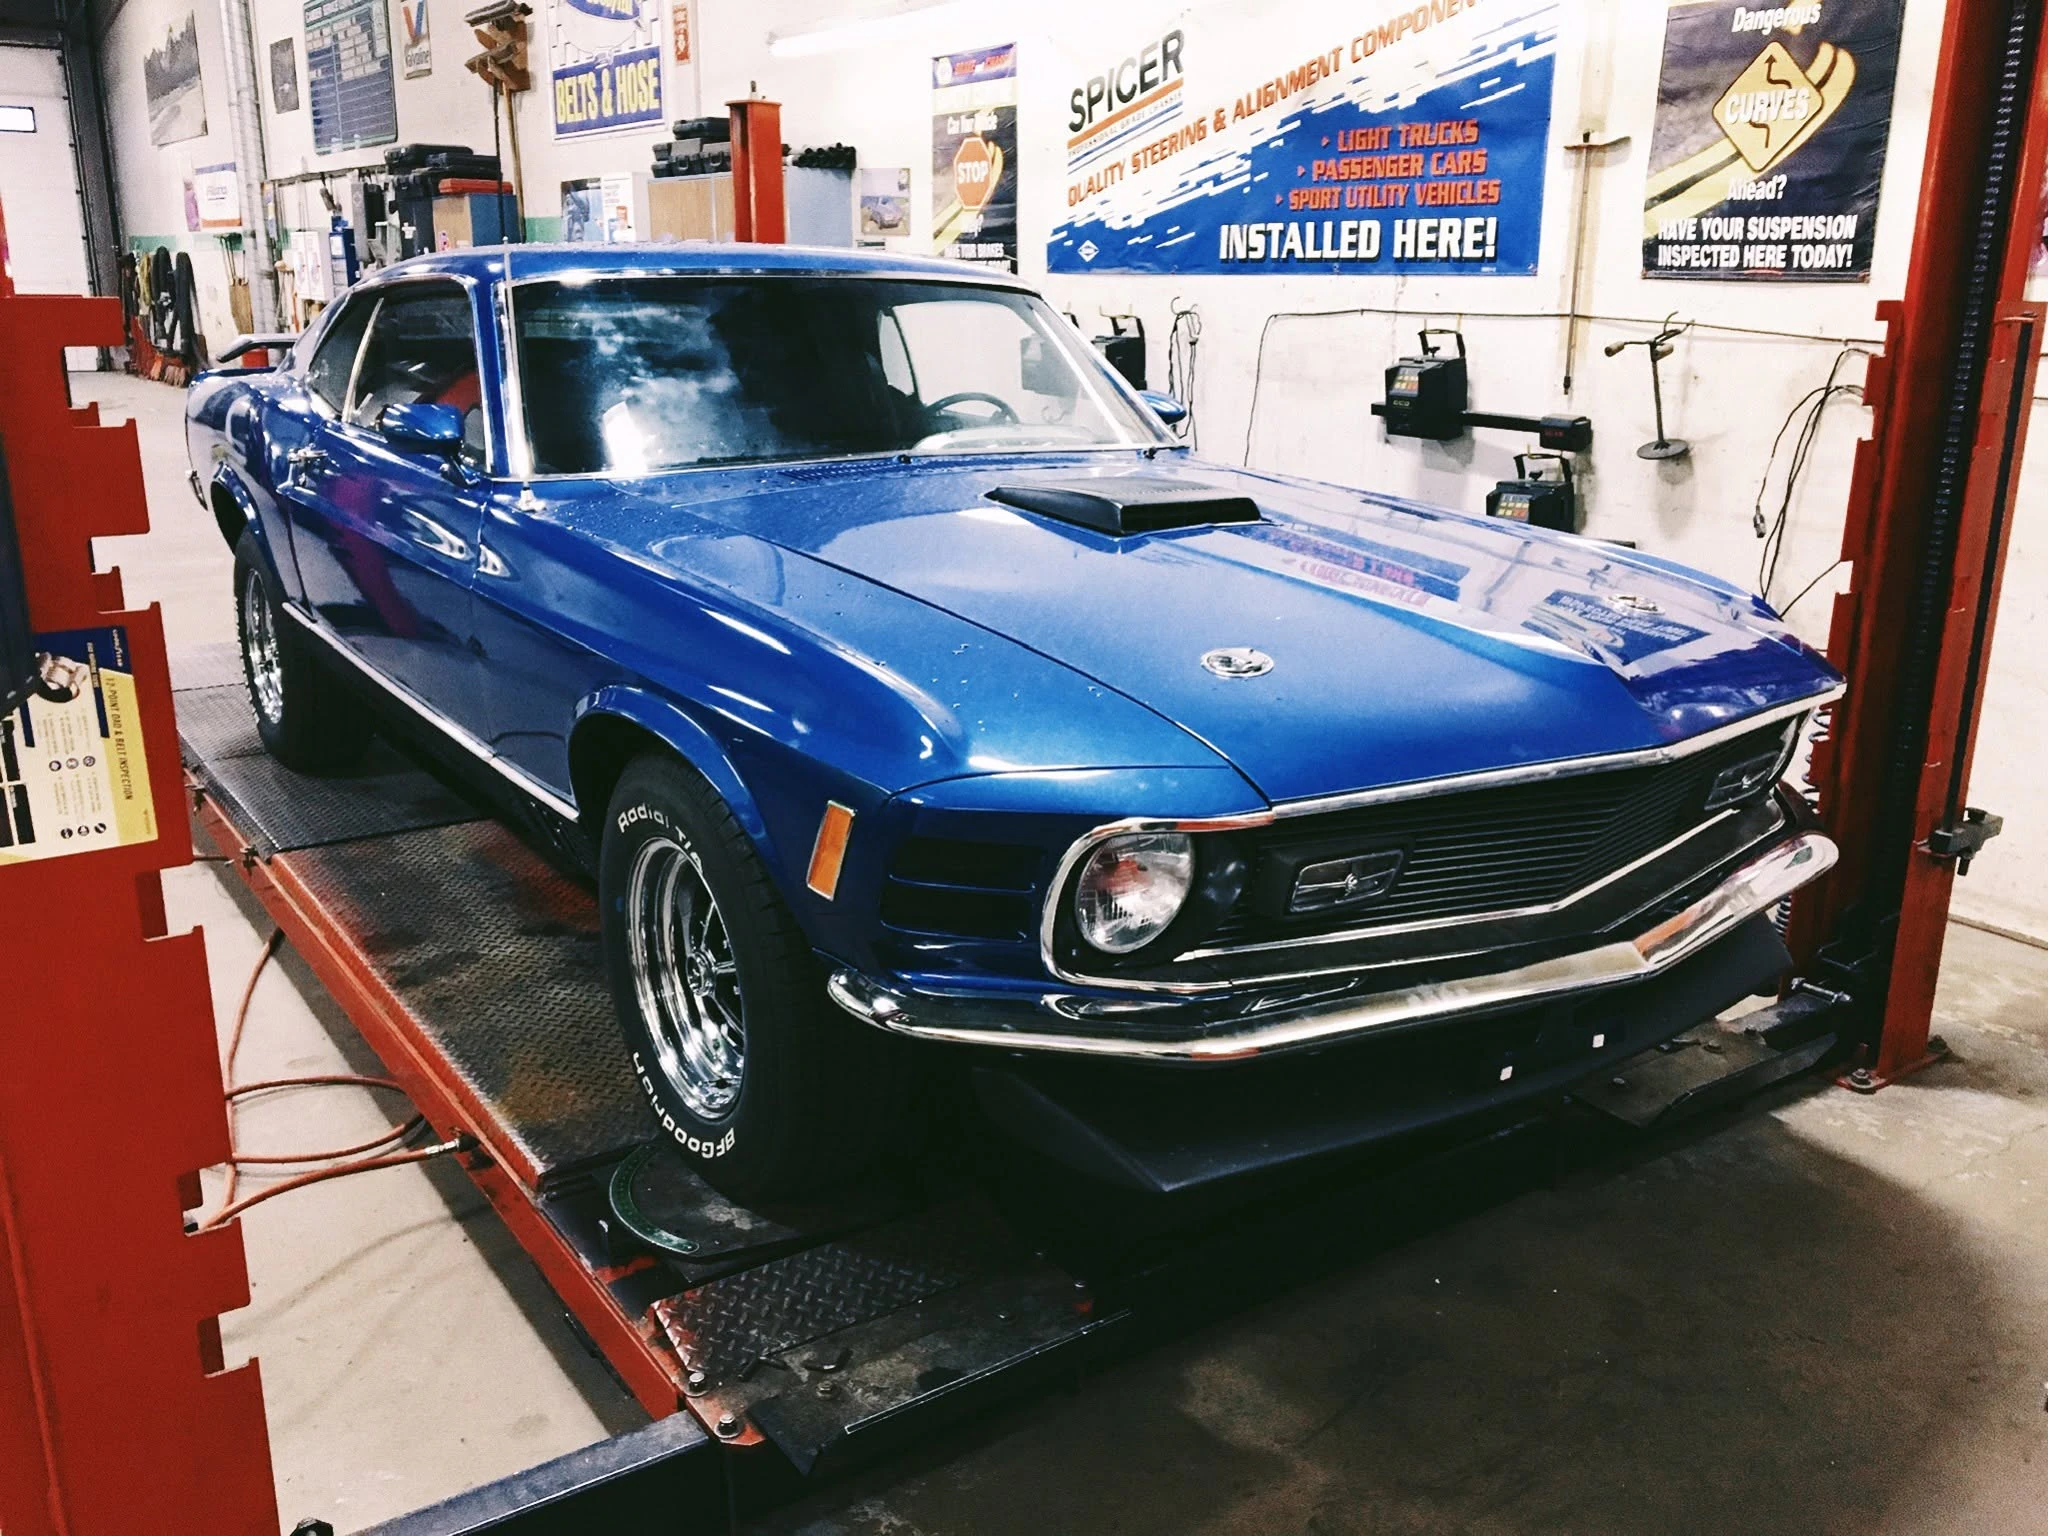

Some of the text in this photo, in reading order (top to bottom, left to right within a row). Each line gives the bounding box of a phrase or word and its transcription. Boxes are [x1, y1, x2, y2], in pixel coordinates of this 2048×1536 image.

[1731, 4, 1822, 35] Dangerous
[555, 58, 660, 124] BELTS & HOSE
[1069, 29, 1184, 132] SPICER
[1724, 88, 1811, 124] CURVES
[1068, 158, 1126, 207] QUALITY
[1131, 116, 1207, 174] STEERING
[1213, 109, 1226, 133] &
[1233, 45, 1343, 124] ALIGNMENT
[1337, 118, 1479, 152] LIGHT TRUCKS
[957, 160, 989, 185] STOP
[1311, 149, 1488, 182] PASSENGER CARS
[1289, 179, 1501, 211] SPORT UTILITY VEHICLES
[1726, 174, 1788, 200] Ahead?
[1219, 217, 1498, 261] INSTALLED HERE!
[1658, 214, 1858, 240] HAVE YOUR SUSPENSION
[1658, 244, 1854, 268] INSPECTED HERE TODAY!
[115, 738, 127, 755] BELT
[120, 757, 133, 800] INSPECTION
[618, 802, 669, 833] Radial
[633, 1052, 736, 1159] BFGoodrich
